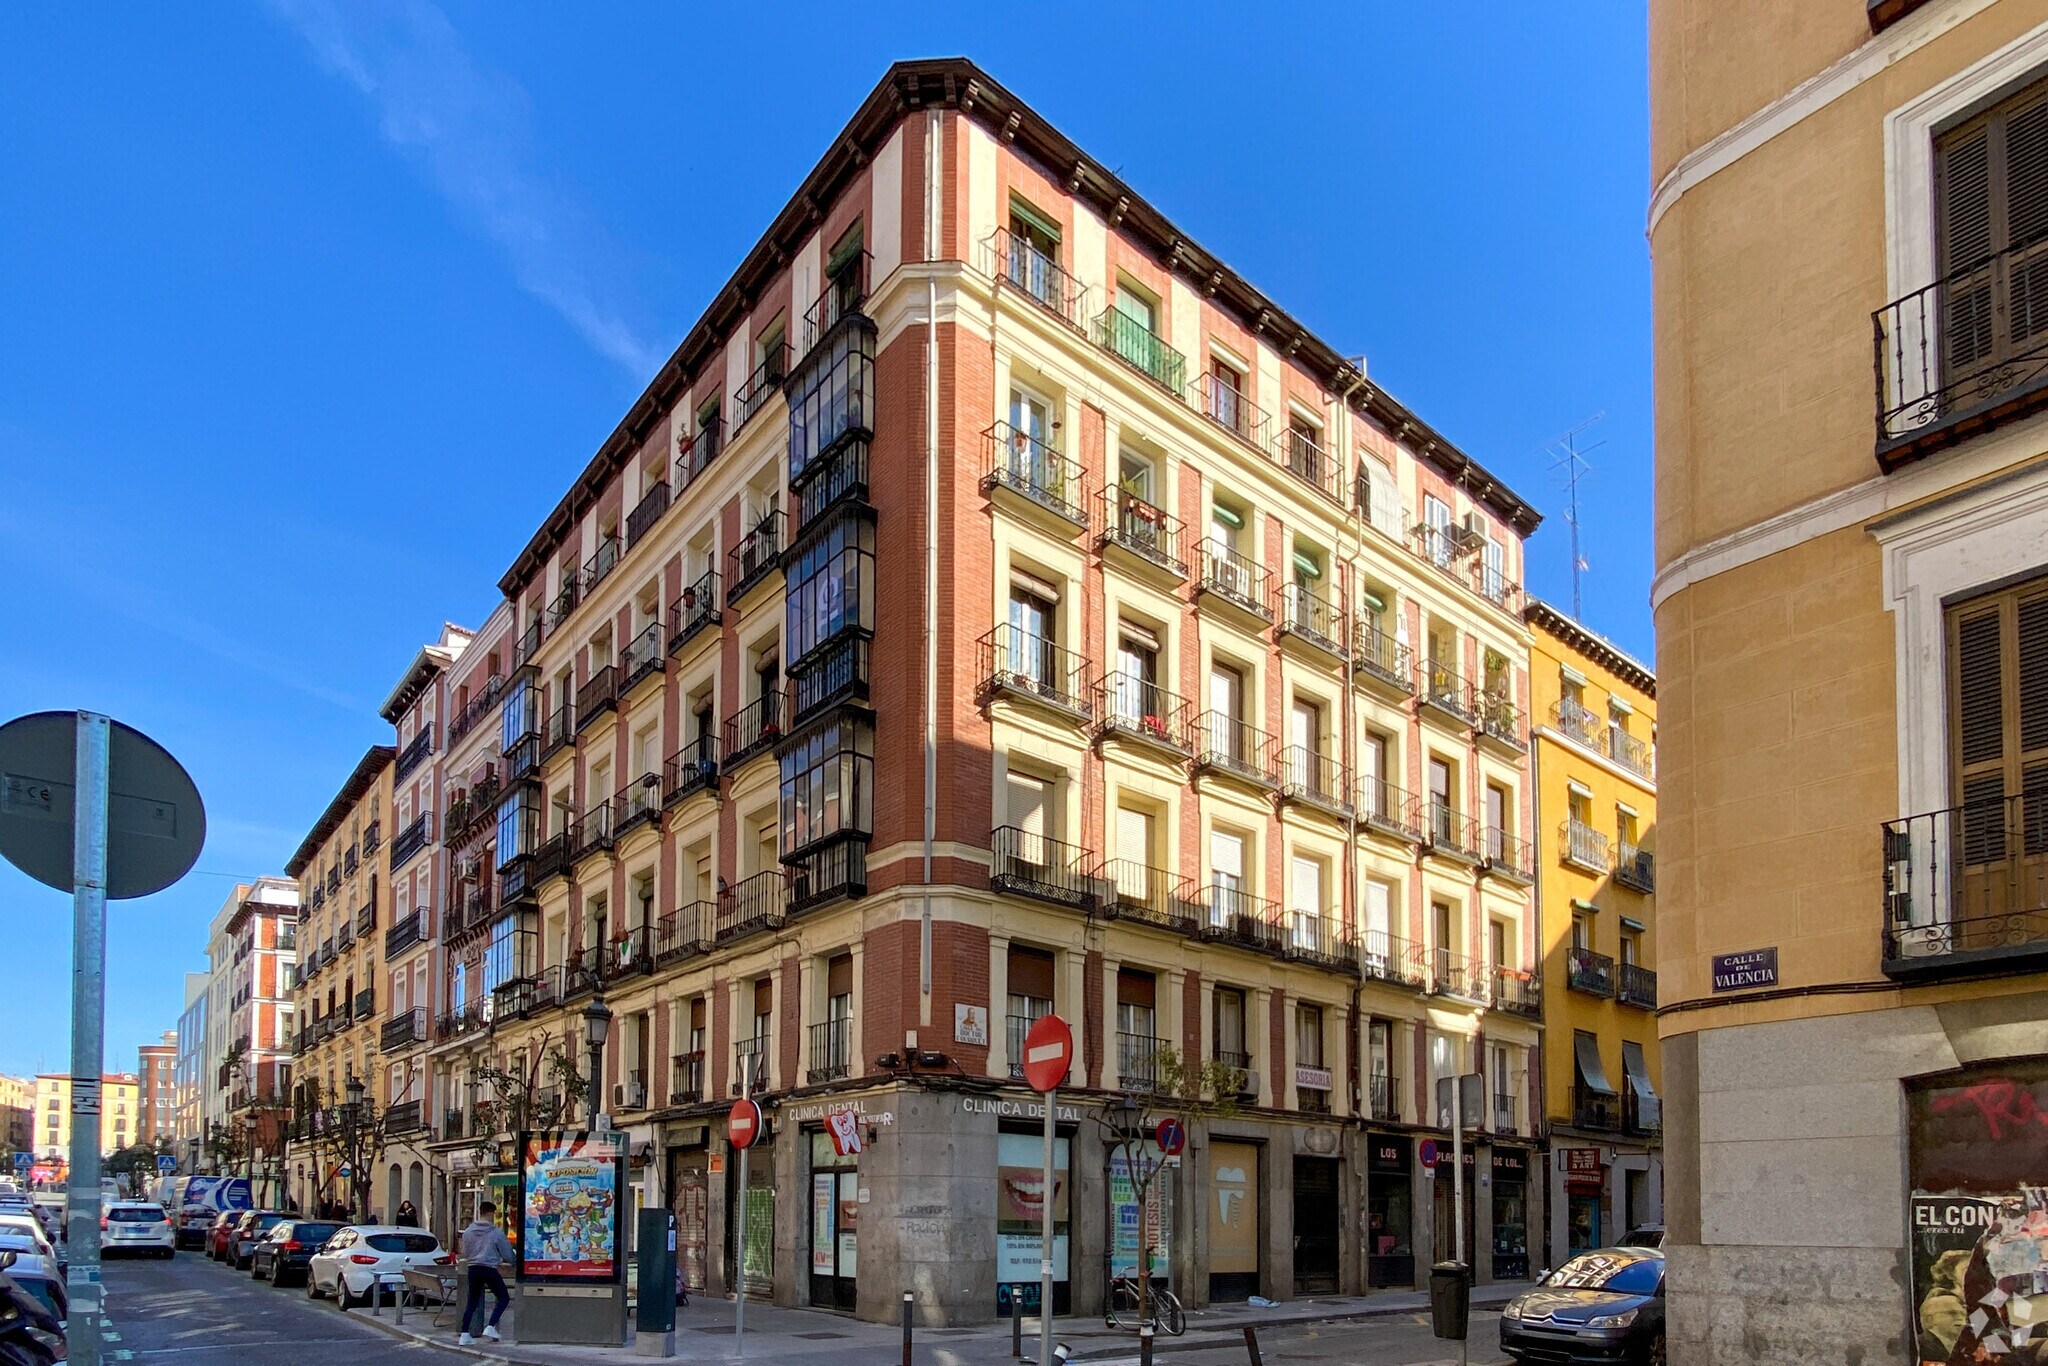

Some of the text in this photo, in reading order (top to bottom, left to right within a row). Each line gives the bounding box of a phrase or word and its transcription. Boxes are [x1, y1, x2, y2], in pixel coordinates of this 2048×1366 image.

[1723, 953, 1764, 966] CALLE
[1715, 968, 1774, 987] VALENCIA
[1296, 1069, 1331, 1087] ASESORIA
[789, 1101, 867, 1121] CLINICA DENTAL
[962, 1098, 1082, 1121] CLINICA DETAL
[1380, 1147, 1397, 1159] LOS
[1436, 1151, 1474, 1165] PLACES
[1493, 1157, 1502, 1167] DE
[668, 1215, 675, 1227] P
[1915, 1205, 2001, 1226] EL CON
